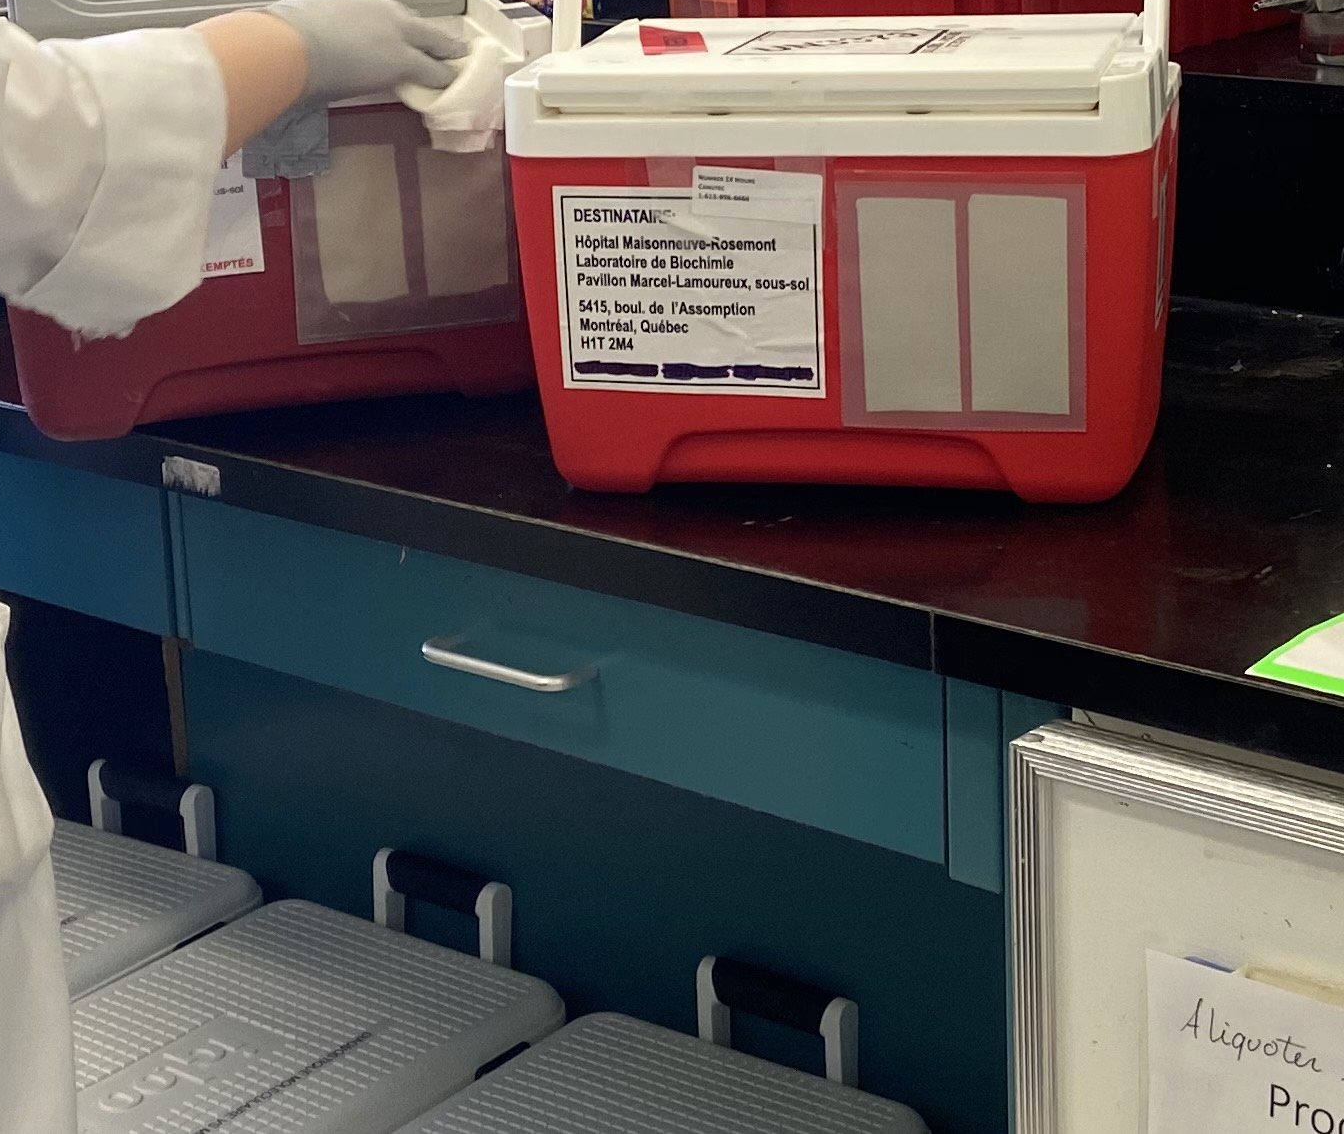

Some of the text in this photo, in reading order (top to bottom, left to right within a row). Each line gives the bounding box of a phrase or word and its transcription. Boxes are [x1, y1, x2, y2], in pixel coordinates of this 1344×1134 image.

[575, 235, 777, 252] Hôpital Maisonneuve-Rosemont
[201, 258, 255, 273] EMPTÉS
[576, 254, 734, 270] Laboratoire de Biochimie
[577, 273, 810, 291] Pavillon Marcel-Lamoureux, sous-sol
[578, 300, 756, 319] 5415, boul. de l'Assomption
[579, 319, 689, 335] Montréal, Québec
[581, 336, 634, 351] H1T 2M4
[1180, 998, 1323, 1074] Aliquoter
